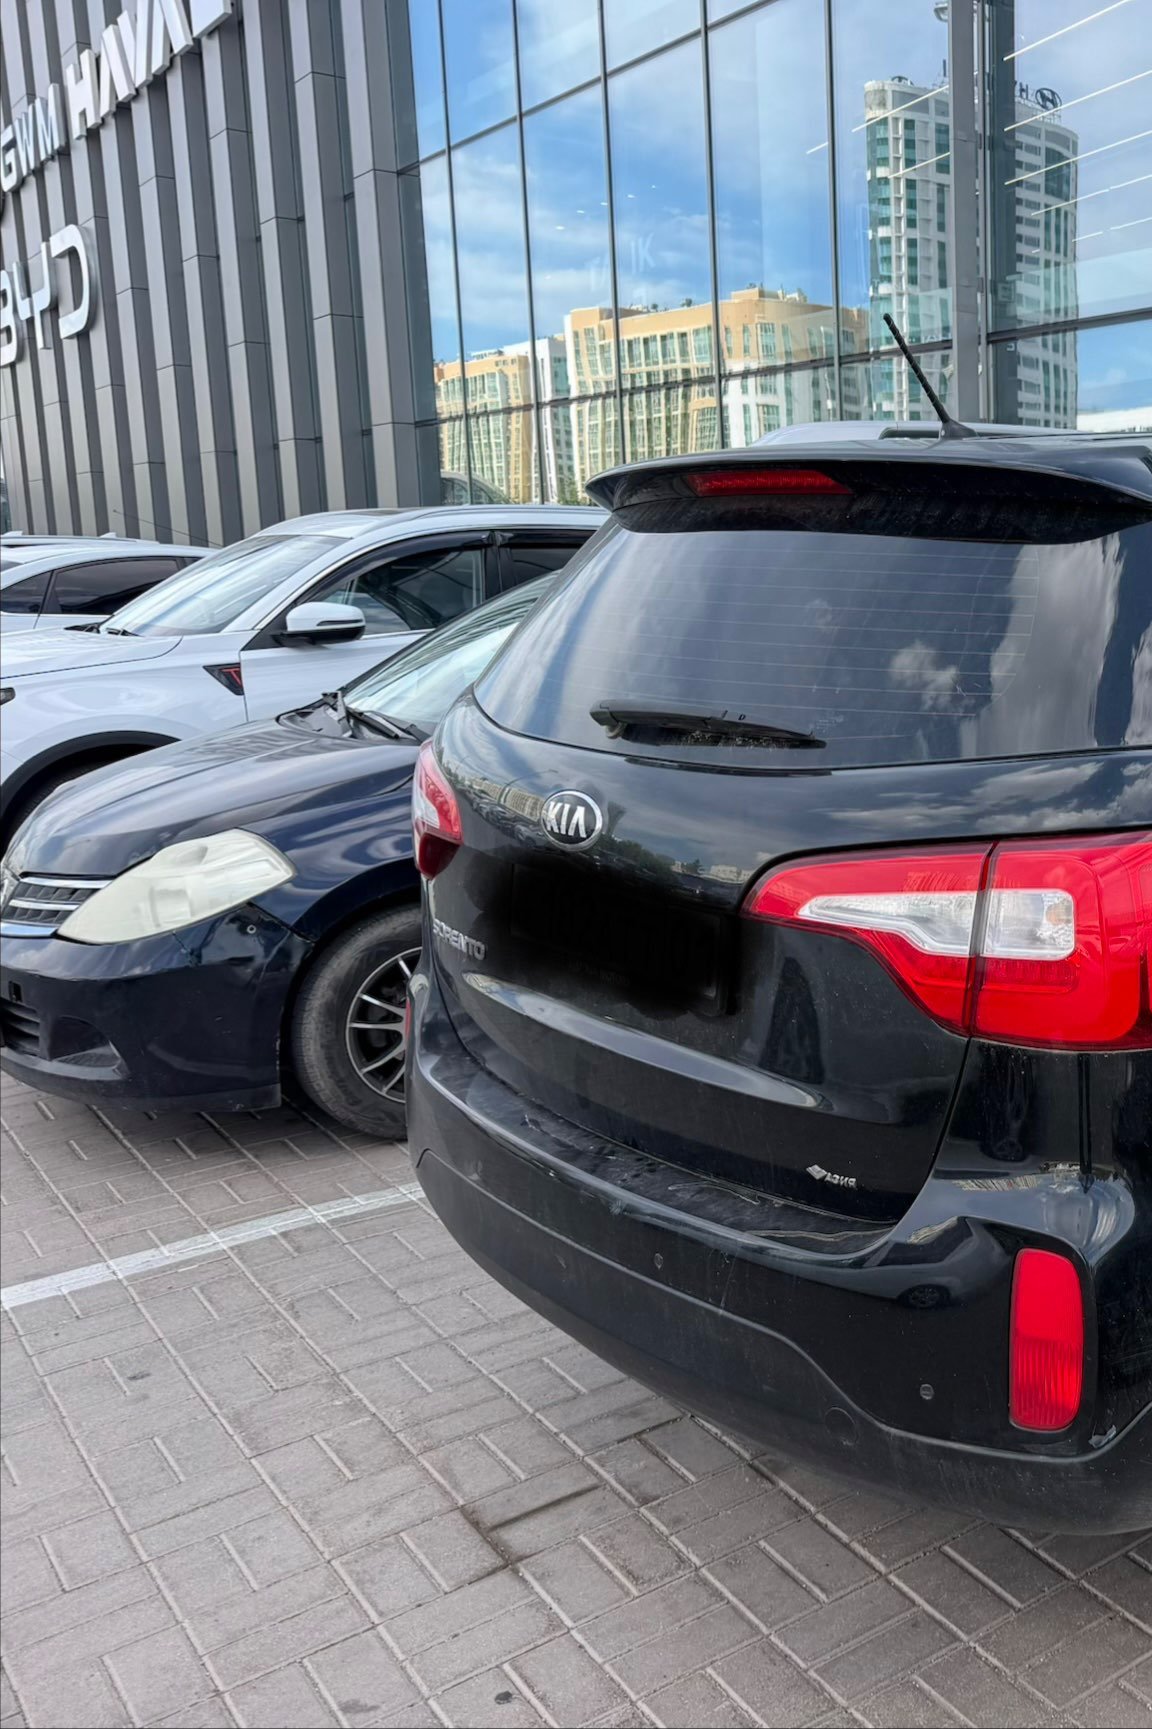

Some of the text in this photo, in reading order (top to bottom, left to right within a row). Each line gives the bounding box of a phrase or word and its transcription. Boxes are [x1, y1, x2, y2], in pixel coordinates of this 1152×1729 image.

[0, 83, 67, 193] GWM
[546, 801, 587, 838] KIA
[432, 917, 485, 960] SORENTO
